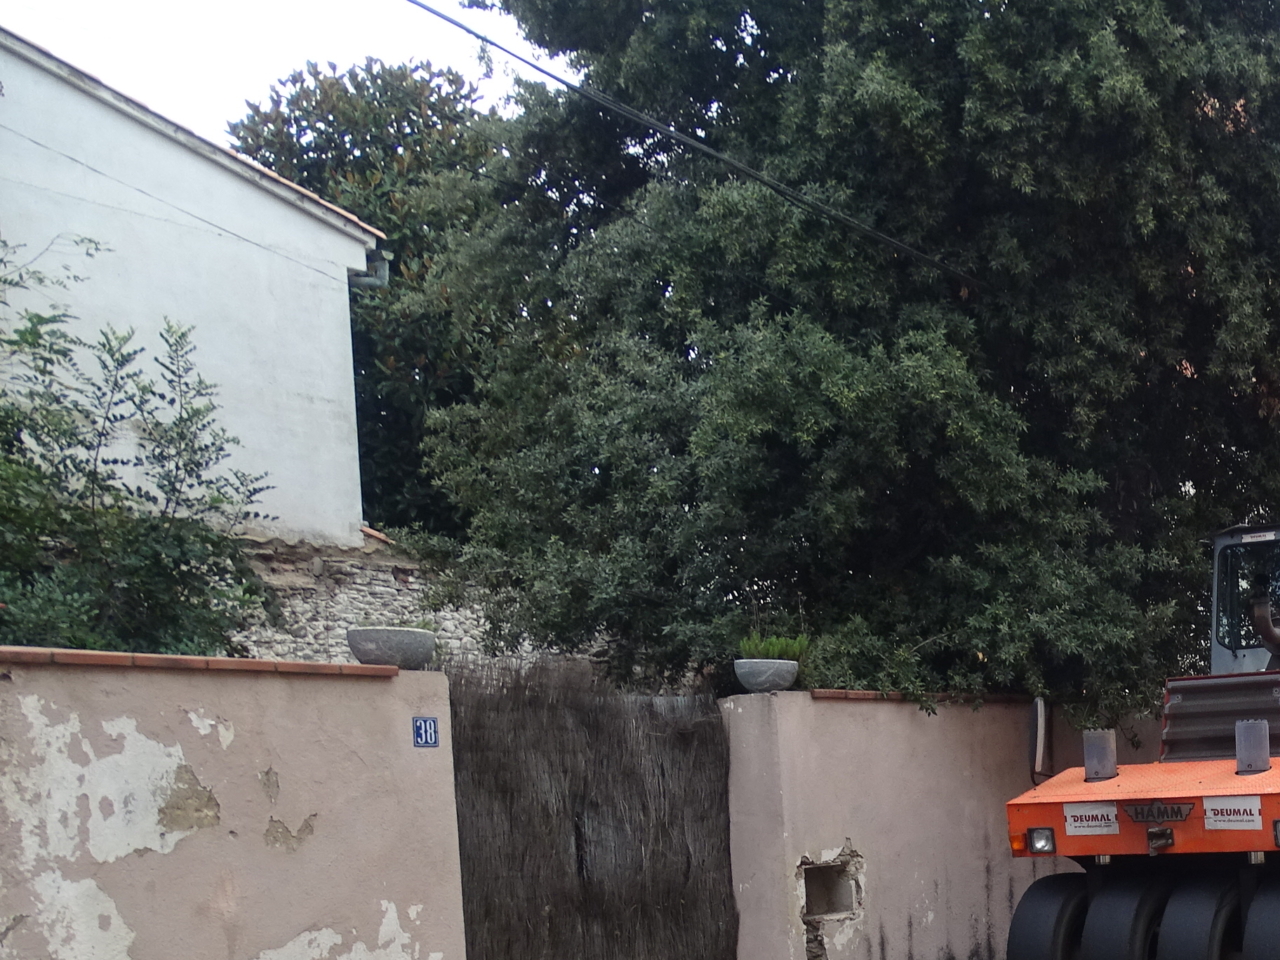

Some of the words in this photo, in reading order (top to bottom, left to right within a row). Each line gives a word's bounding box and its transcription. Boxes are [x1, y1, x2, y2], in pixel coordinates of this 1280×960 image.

[416, 720, 436, 744] 38
[1071, 813, 1112, 823] DEUMAL
[1134, 805, 1183, 820] HAMM
[1210, 808, 1255, 817] DEUMAL
